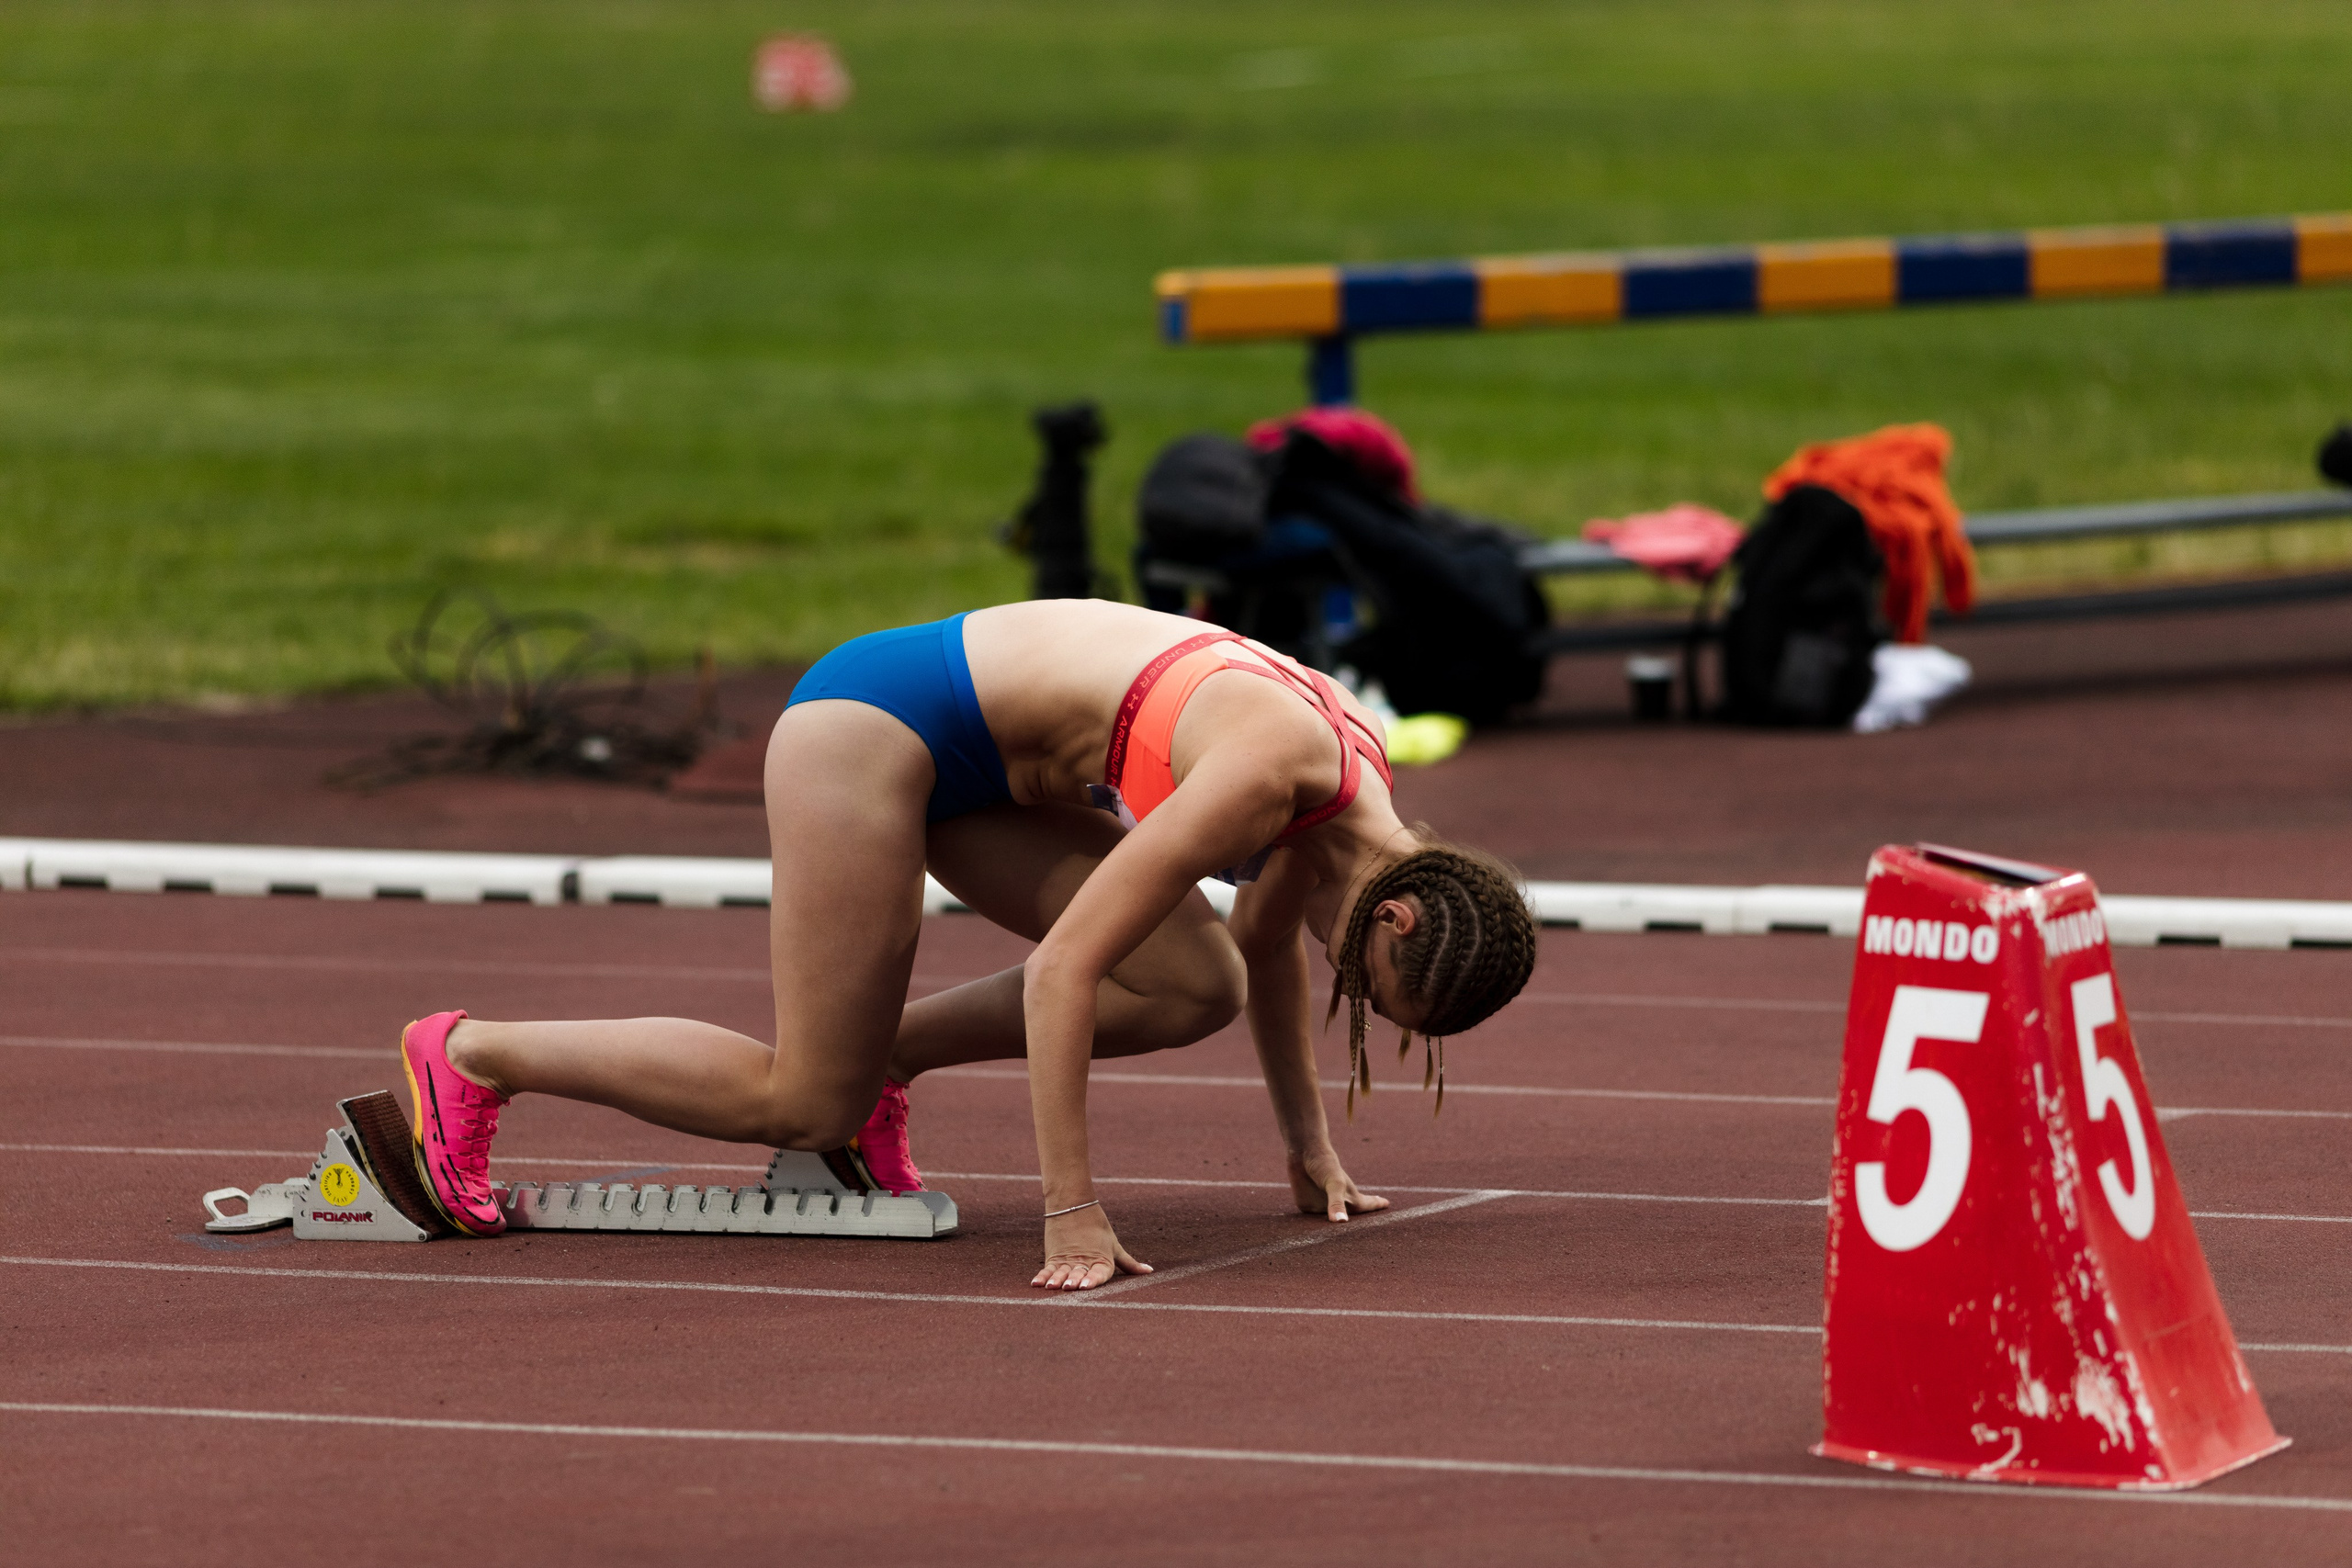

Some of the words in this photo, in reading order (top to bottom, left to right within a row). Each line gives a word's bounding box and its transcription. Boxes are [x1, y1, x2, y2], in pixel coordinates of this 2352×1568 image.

[1139, 647, 1186, 689] UNDER
[1111, 715, 1128, 775] ARMOUR
[1864, 914, 2000, 964] MONDO
[2045, 907, 2106, 957] MONDO
[1855, 984, 1990, 1252] 5
[2071, 971, 2156, 1241] 5
[312, 1212, 374, 1223] POLANIK
